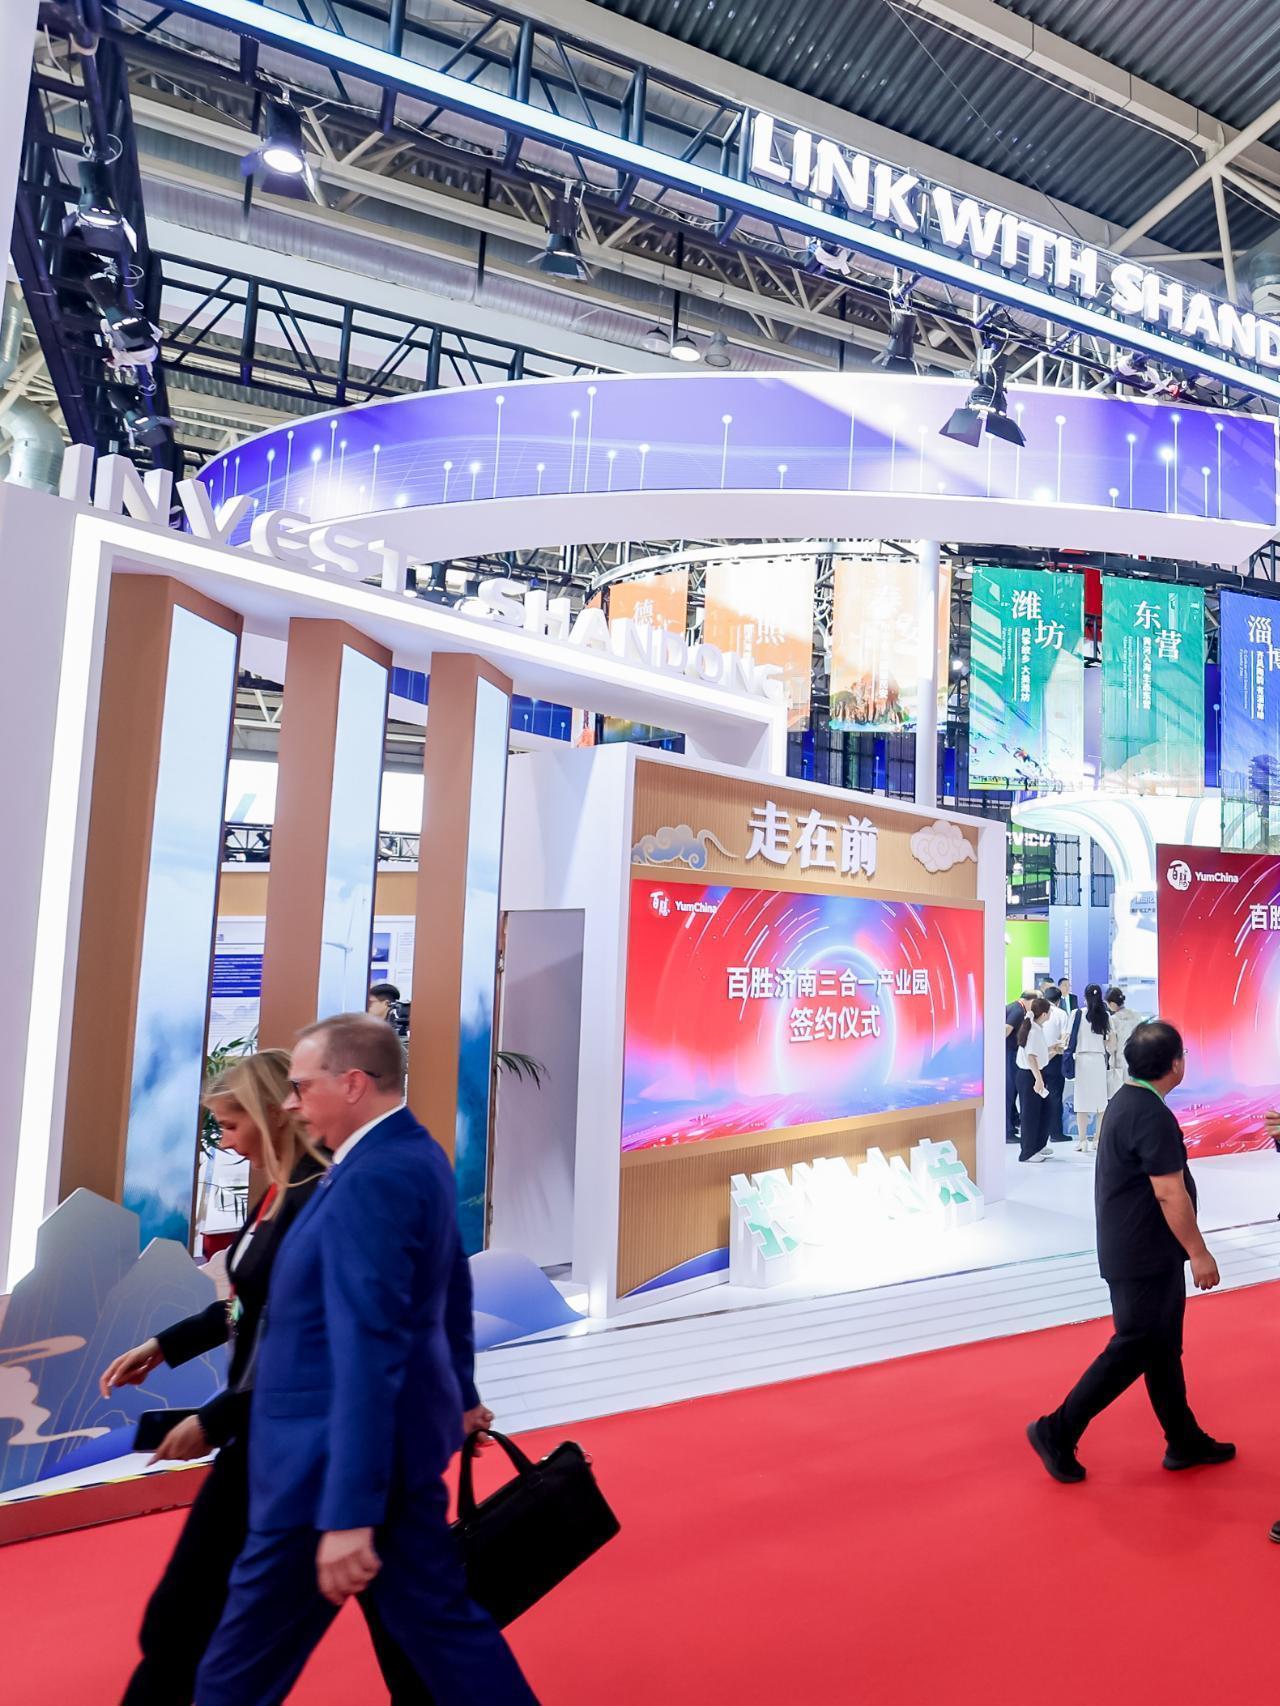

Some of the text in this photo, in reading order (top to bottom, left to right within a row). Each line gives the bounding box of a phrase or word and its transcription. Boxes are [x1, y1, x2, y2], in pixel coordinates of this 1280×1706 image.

[751, 113, 920, 233] LINK
[932, 186, 1097, 299] WITH
[453, 578, 787, 700] SHANDONG
[1011, 589, 1065, 650] 潍坊
[1133, 600, 1182, 661] 东营
[745, 800, 880, 877] 走在前
[675, 901, 717, 913] YumChina
[1195, 871, 1239, 883] YumChina
[727, 966, 929, 999] 百胜济南三合一产业园
[790, 1005, 881, 1043] 签约仪式
